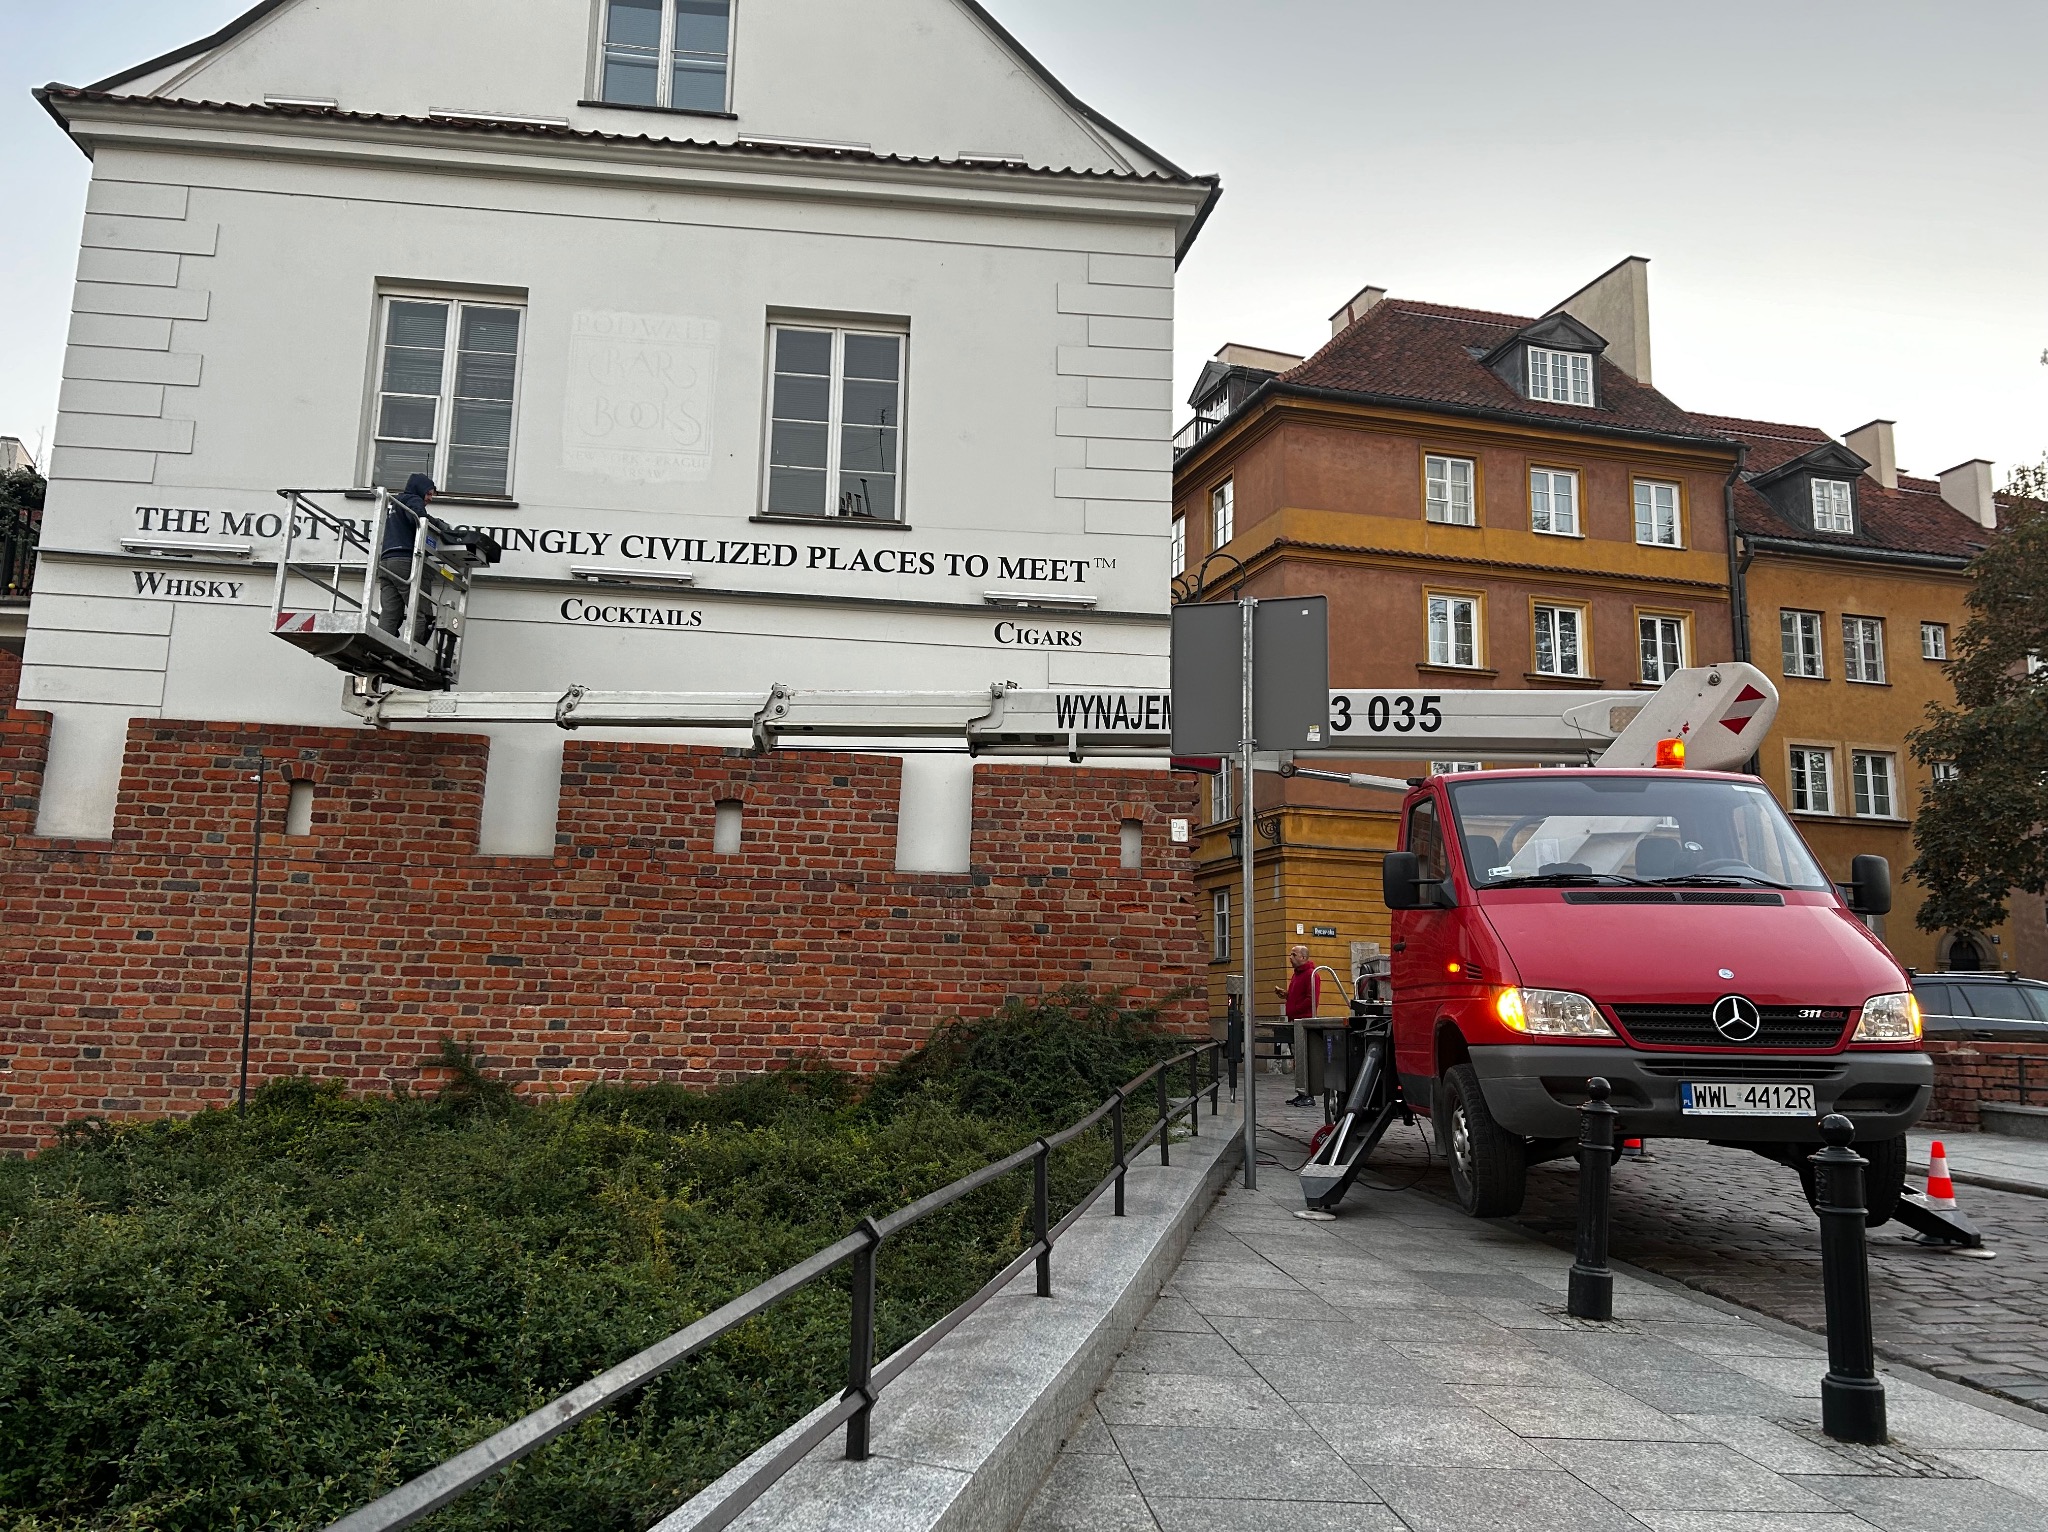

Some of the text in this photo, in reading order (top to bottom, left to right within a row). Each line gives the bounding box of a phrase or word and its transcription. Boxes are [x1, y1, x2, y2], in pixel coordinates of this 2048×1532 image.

[577, 314, 715, 340] PODWALE
[577, 383, 702, 446] BOOKS
[135, 506, 210, 534] THE
[620, 535, 798, 567] CIVILIZED
[806, 545, 935, 576] PLACES
[944, 553, 989, 578] TO
[997, 556, 1090, 583] MEET
[132, 570, 243, 598] WHISKY
[560, 598, 702, 627] COCKTAILS
[994, 621, 1082, 647] CIGARS
[1367, 695, 1442, 732] 035
[1693, 1085, 1737, 1108] WWL
[1744, 1086, 1812, 1109] 4412R
